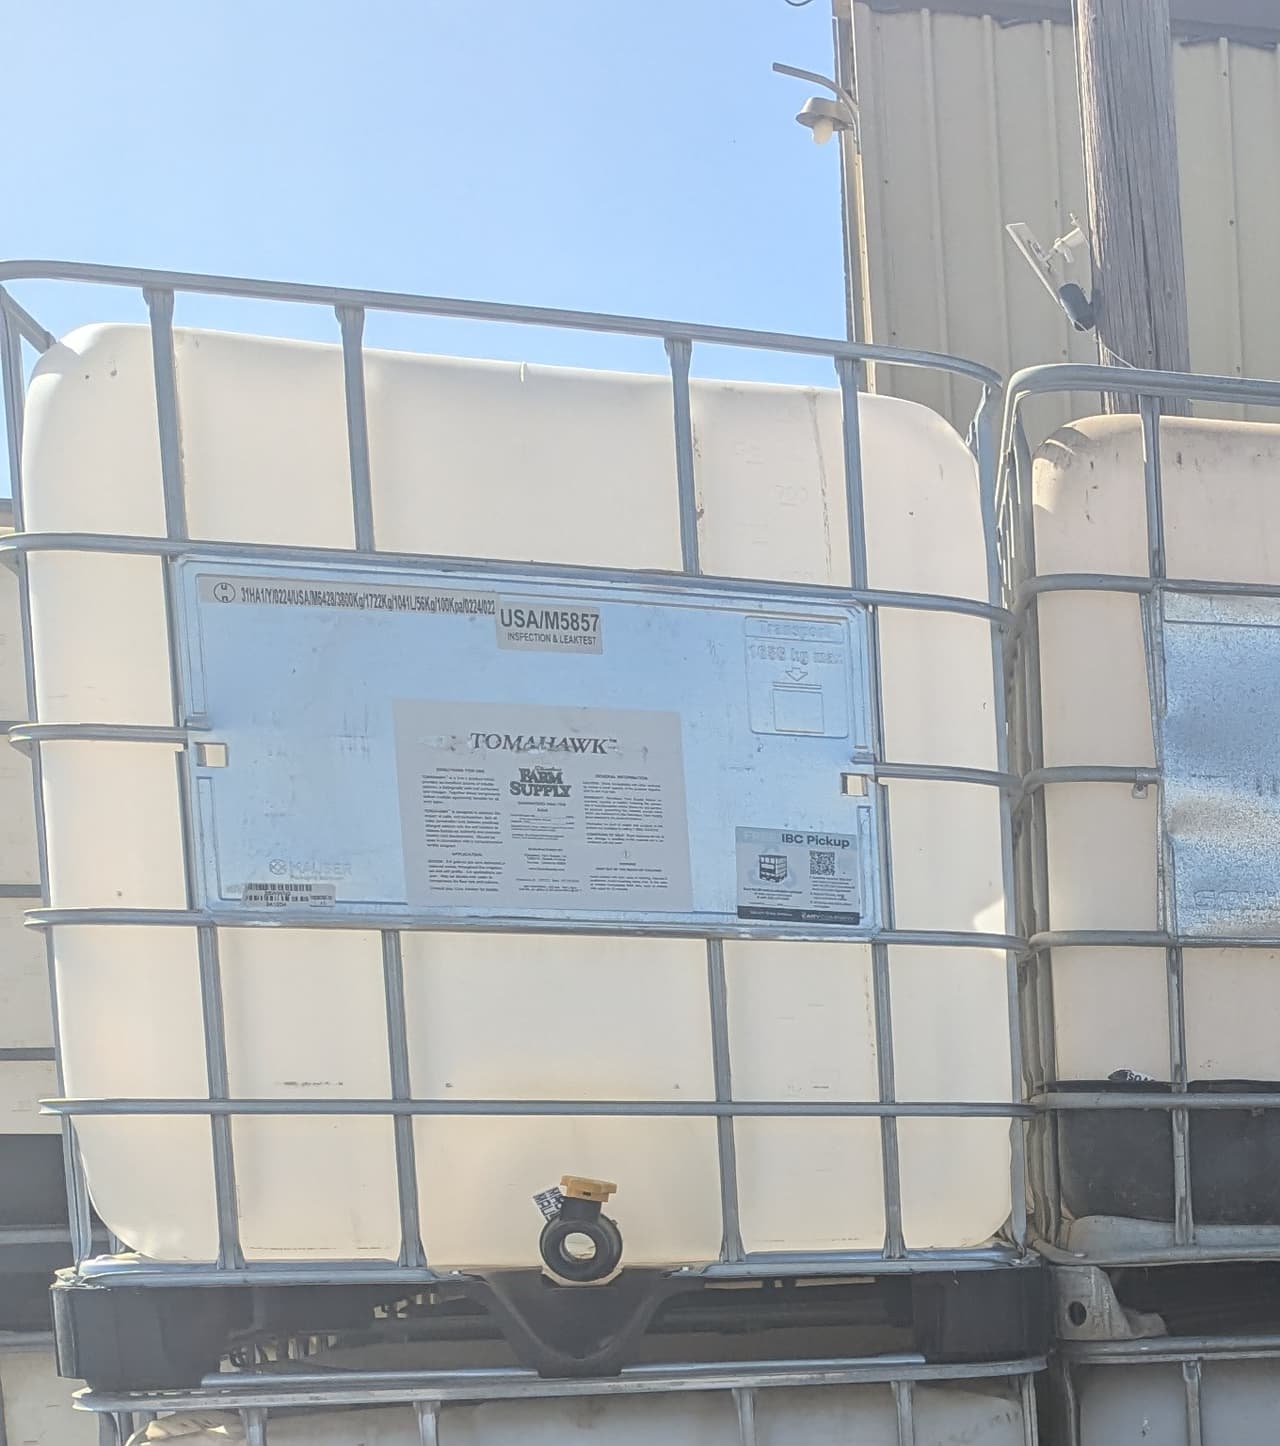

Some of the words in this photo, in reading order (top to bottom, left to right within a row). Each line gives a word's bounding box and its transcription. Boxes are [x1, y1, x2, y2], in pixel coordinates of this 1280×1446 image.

[501, 608, 599, 632] USA/M5857
[507, 632, 551, 643] INSPECTION
[559, 633, 597, 645] LEAKTEST
[510, 781, 572, 797] SUPPLY
[782, 833, 803, 844] IBC
[807, 835, 850, 849] Pickup
